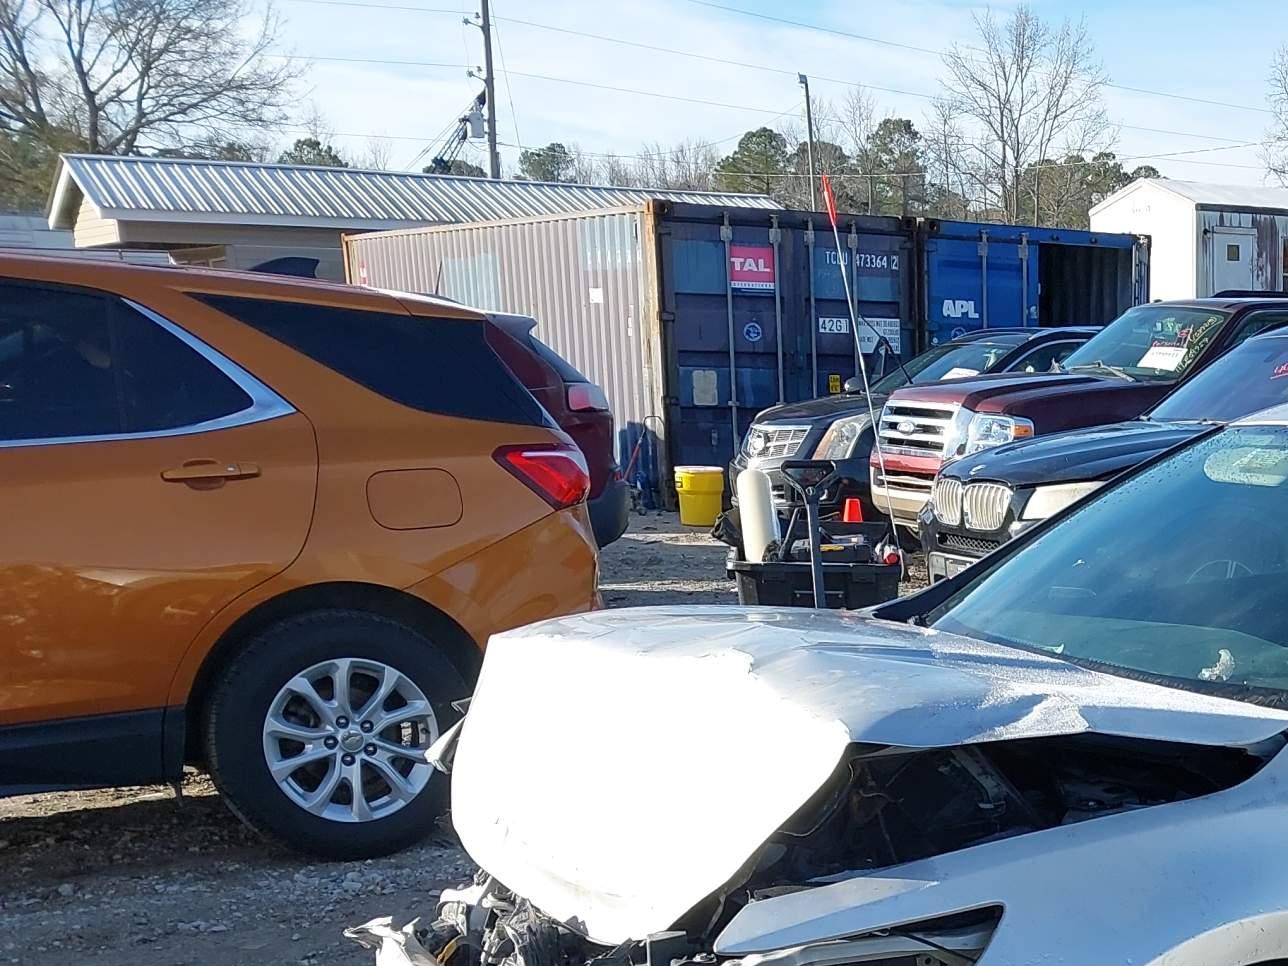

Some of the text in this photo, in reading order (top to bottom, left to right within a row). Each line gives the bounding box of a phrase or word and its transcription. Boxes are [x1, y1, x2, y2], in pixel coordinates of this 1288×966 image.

[730, 257, 771, 271] TAL
[942, 299, 979, 318] APL
[820, 319, 848, 332] 42G1
